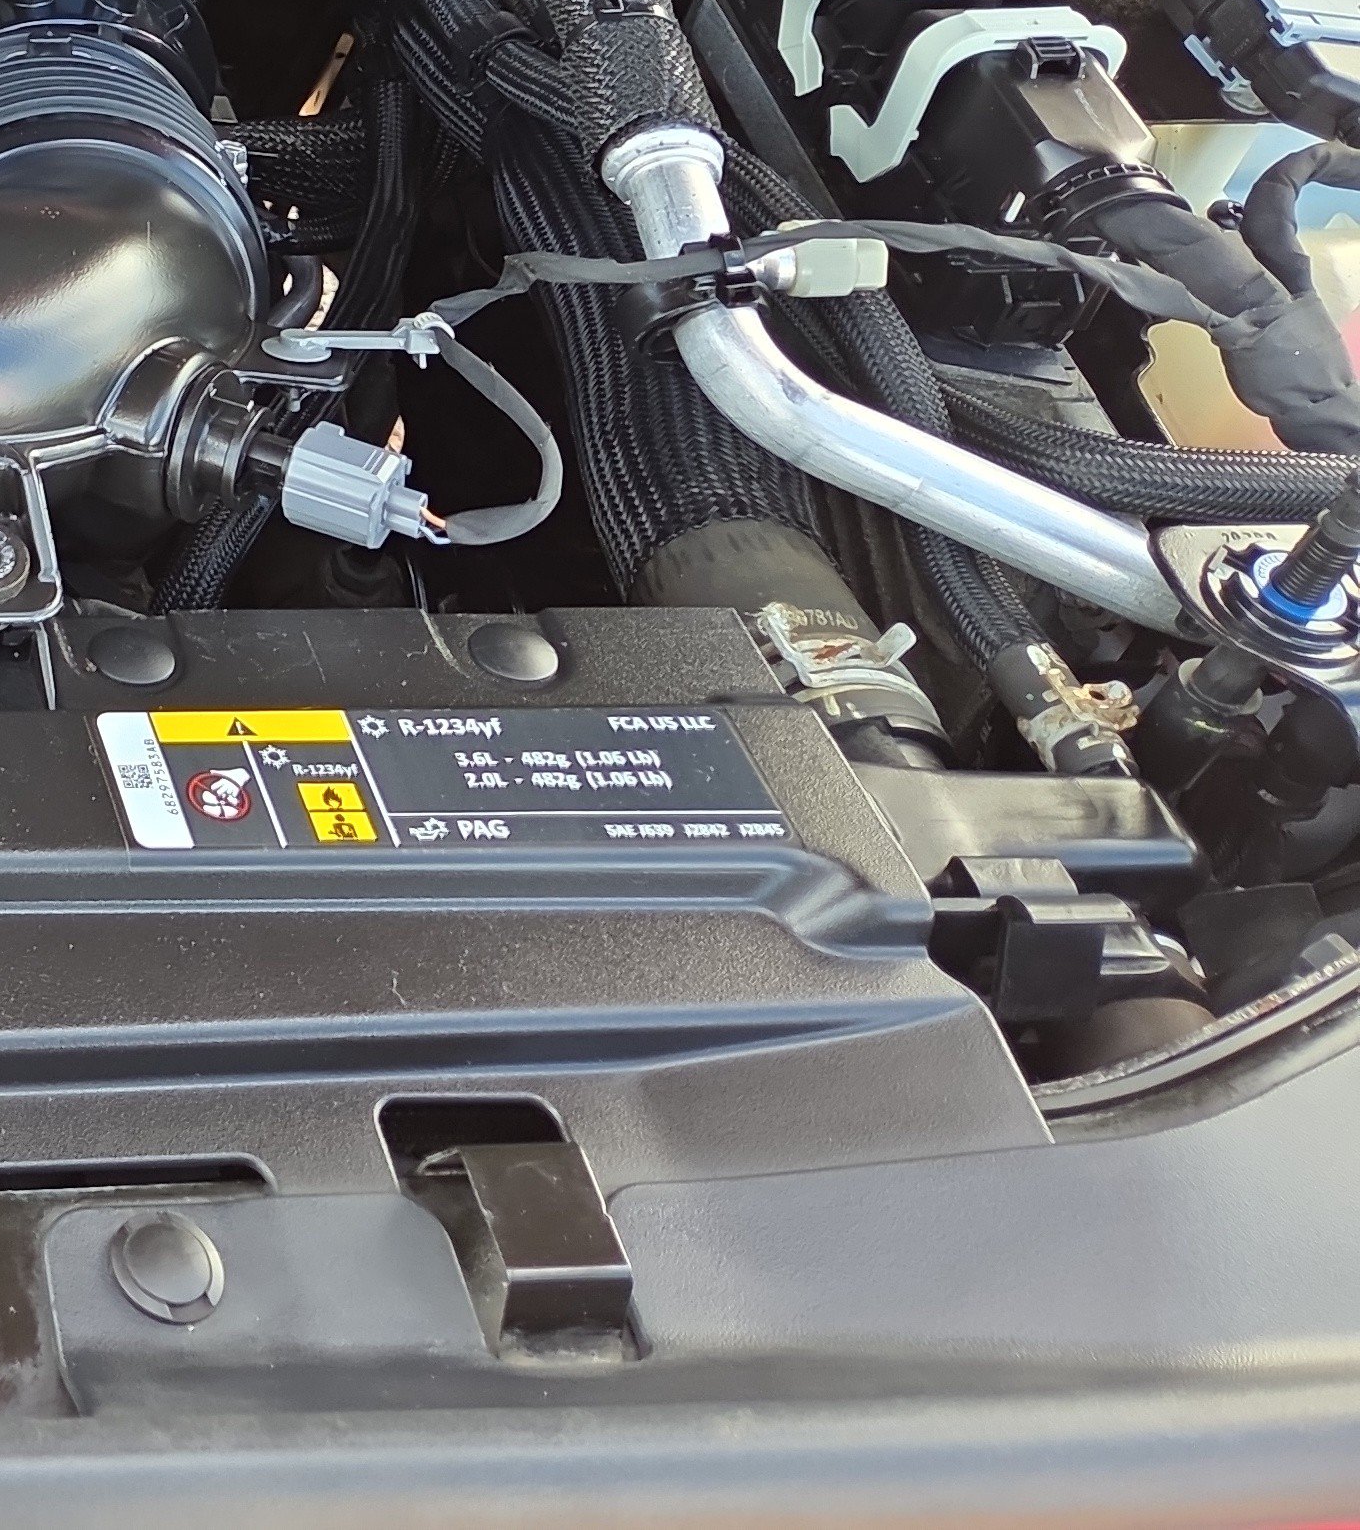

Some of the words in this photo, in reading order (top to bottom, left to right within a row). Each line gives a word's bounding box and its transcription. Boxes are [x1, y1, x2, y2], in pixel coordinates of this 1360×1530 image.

[397, 717, 504, 740] R-1234yf
[607, 716, 648, 732] FCA
[648, 716, 678, 732] US
[678, 715, 717, 731] LLC
[454, 751, 499, 768] 3.6L
[520, 751, 572, 770] 482g
[574, 749, 627, 770] (1.06
[626, 748, 661, 769] Lb)
[291, 762, 360, 780] R-1234yf
[463, 771, 509, 789] 2.0L
[530, 771, 582, 791] 482g
[584, 770, 638, 791] (1.06
[637, 769, 674, 791] Lb)
[456, 819, 511, 840] PAG
[603, 823, 639, 839] SAE
